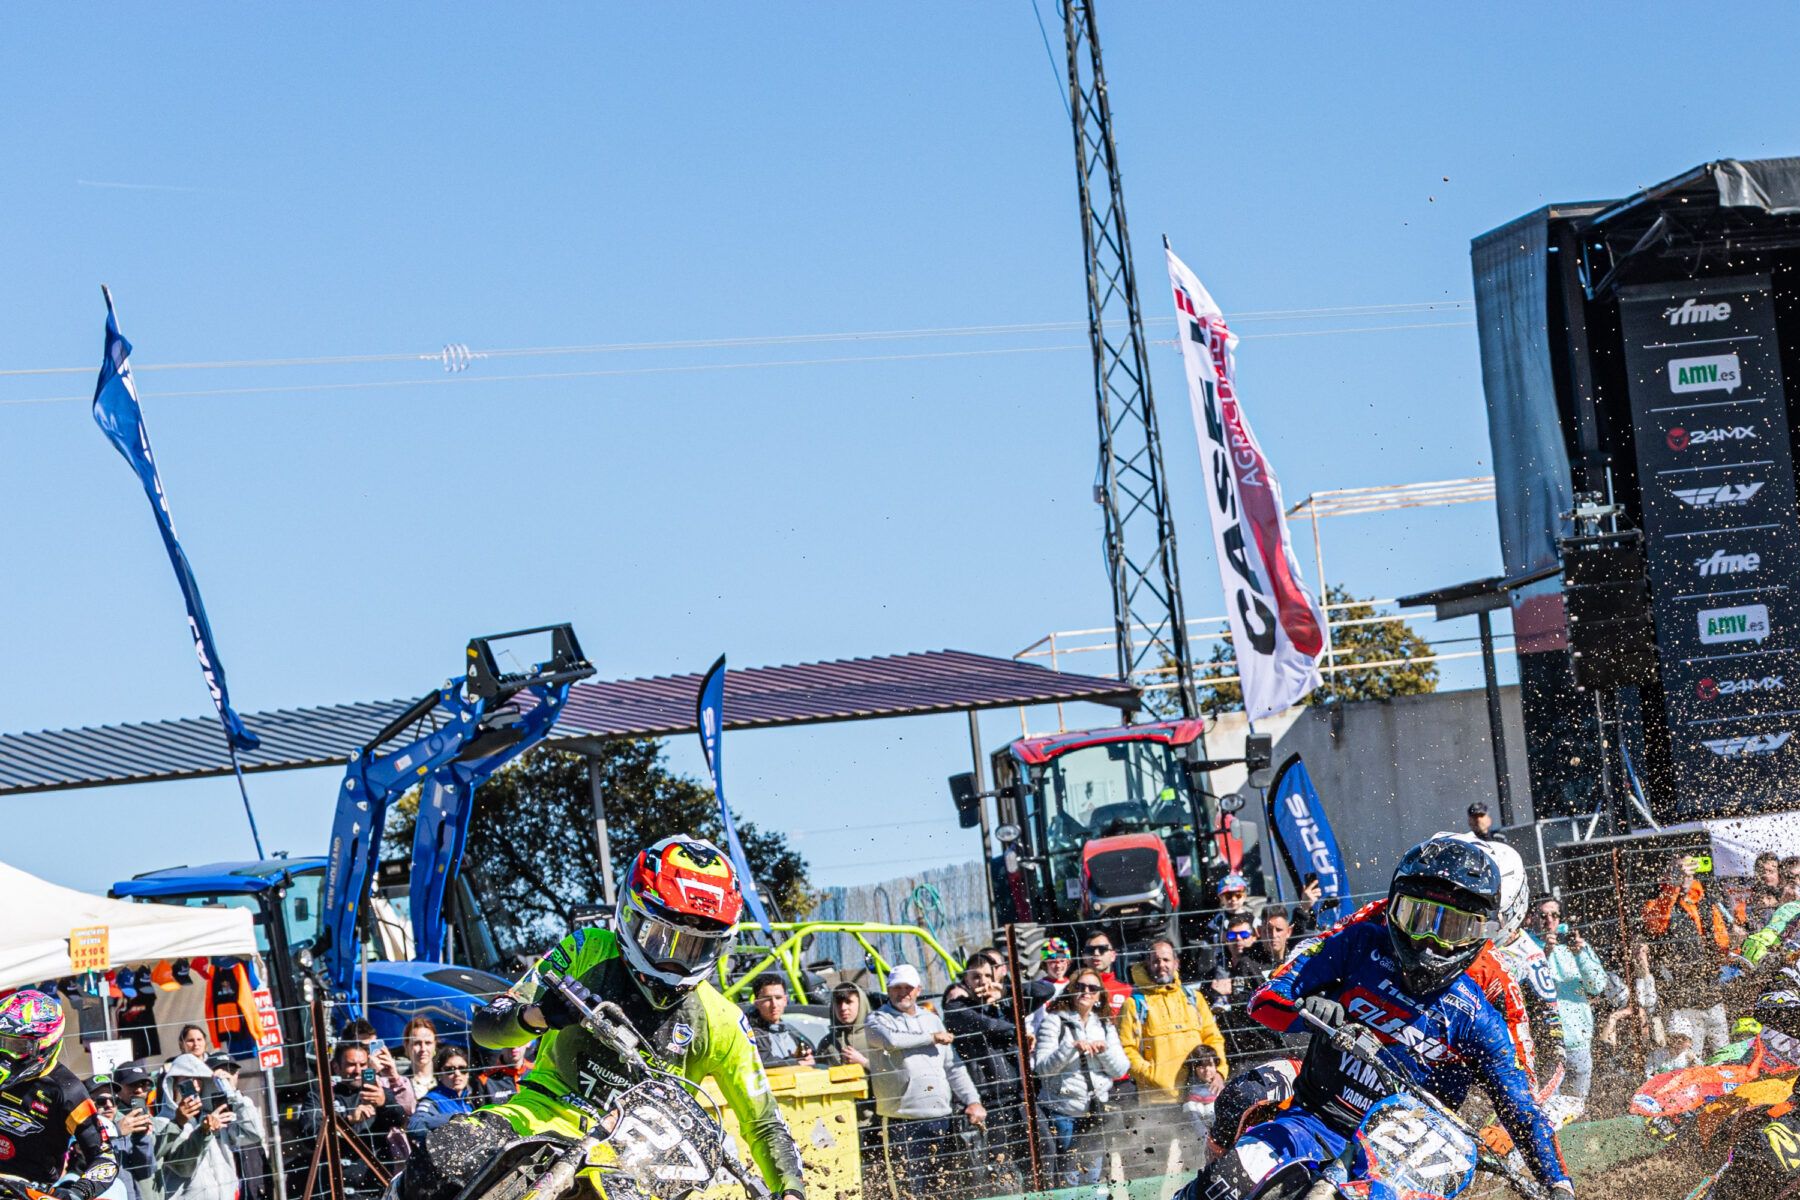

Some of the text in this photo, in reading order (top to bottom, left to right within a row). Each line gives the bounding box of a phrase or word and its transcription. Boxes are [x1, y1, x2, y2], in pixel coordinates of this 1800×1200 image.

[1667, 299, 1731, 326] rfme
[1690, 425, 1757, 445] 24MX
[1199, 377, 1276, 655] CASE
[1697, 550, 1761, 577] rfme
[1719, 675, 1786, 694] 24MX
